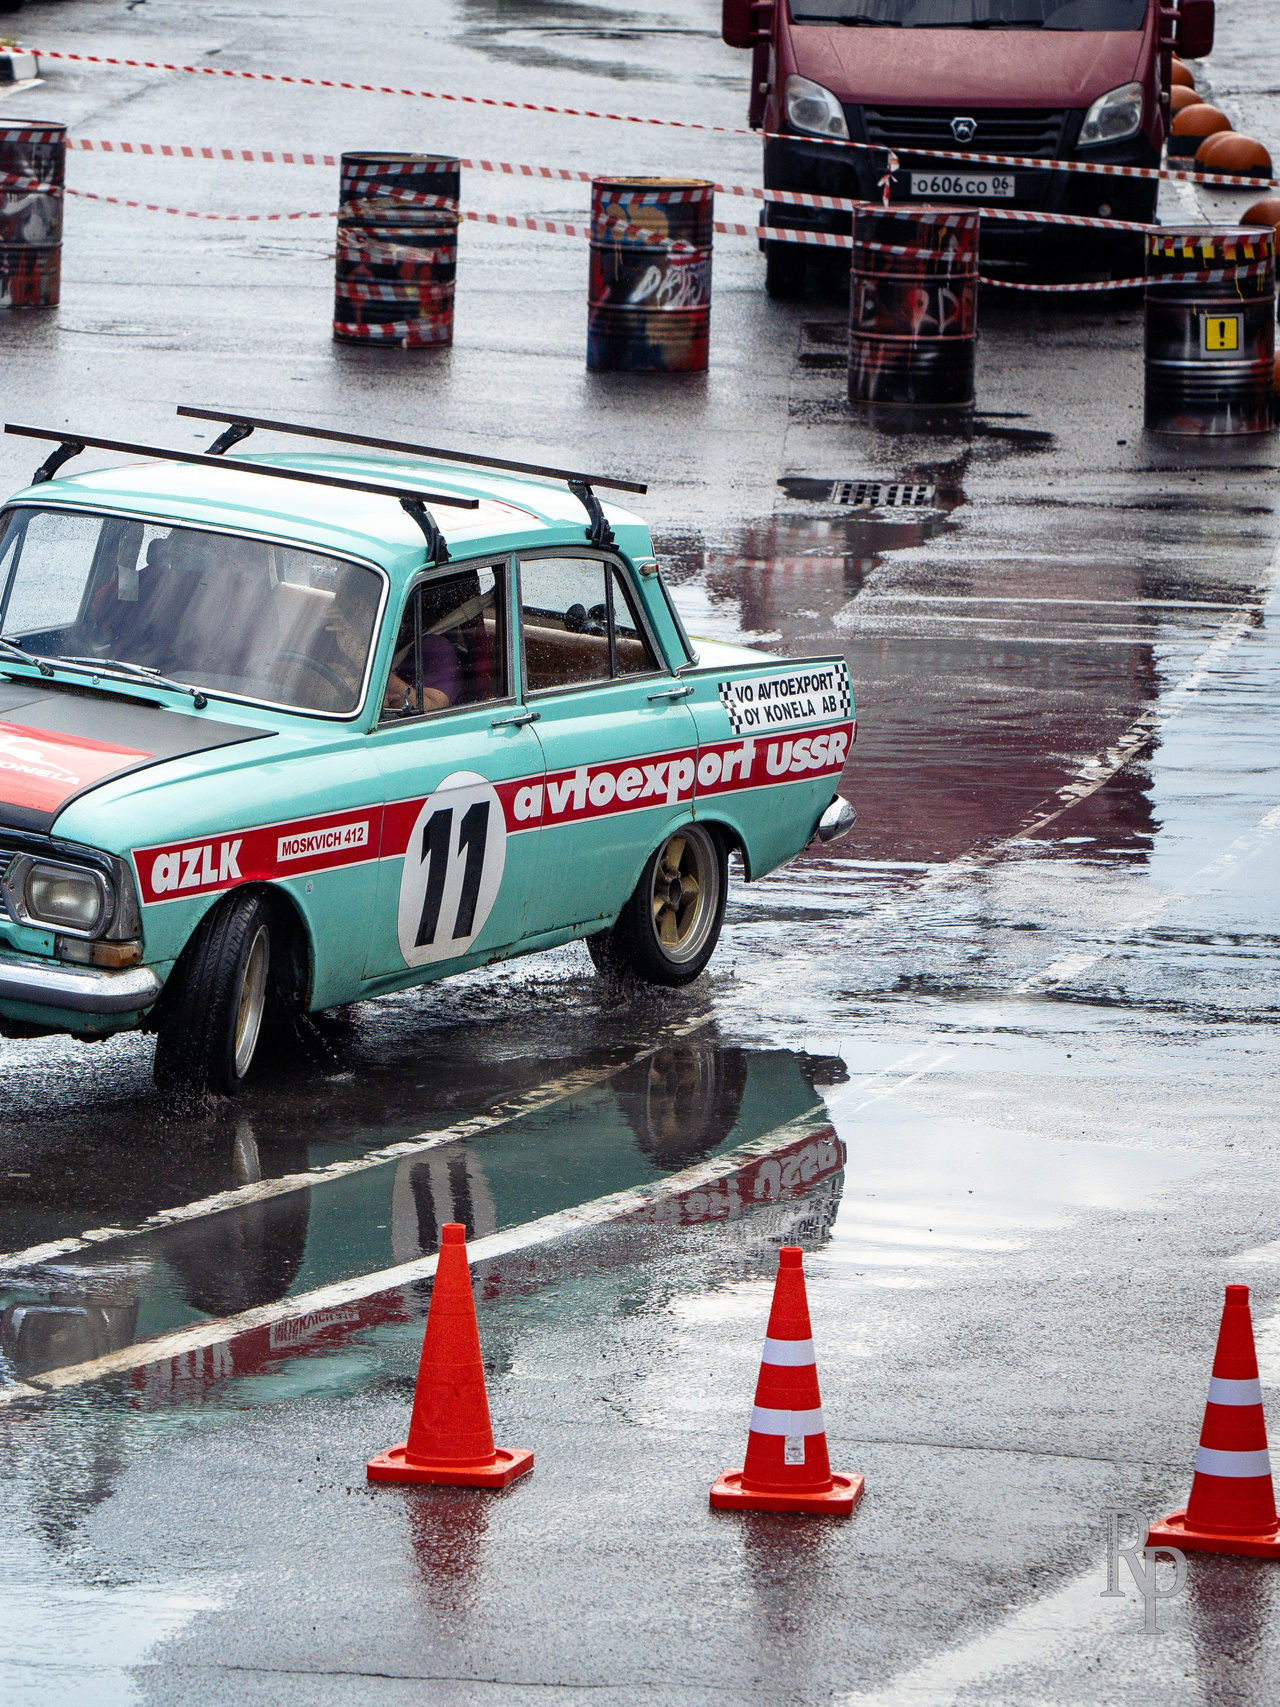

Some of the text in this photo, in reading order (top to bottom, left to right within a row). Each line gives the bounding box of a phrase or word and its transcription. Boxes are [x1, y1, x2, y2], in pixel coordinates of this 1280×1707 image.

[992, 177, 1009, 189] 06
[735, 672, 834, 703] VO AVTOEXPORT
[744, 695, 837, 726] OY KONELA AB
[513, 731, 849, 822] avtoexport USSR
[282, 827, 364, 856] MOSKVICH 412
[414, 801, 490, 947] 11
